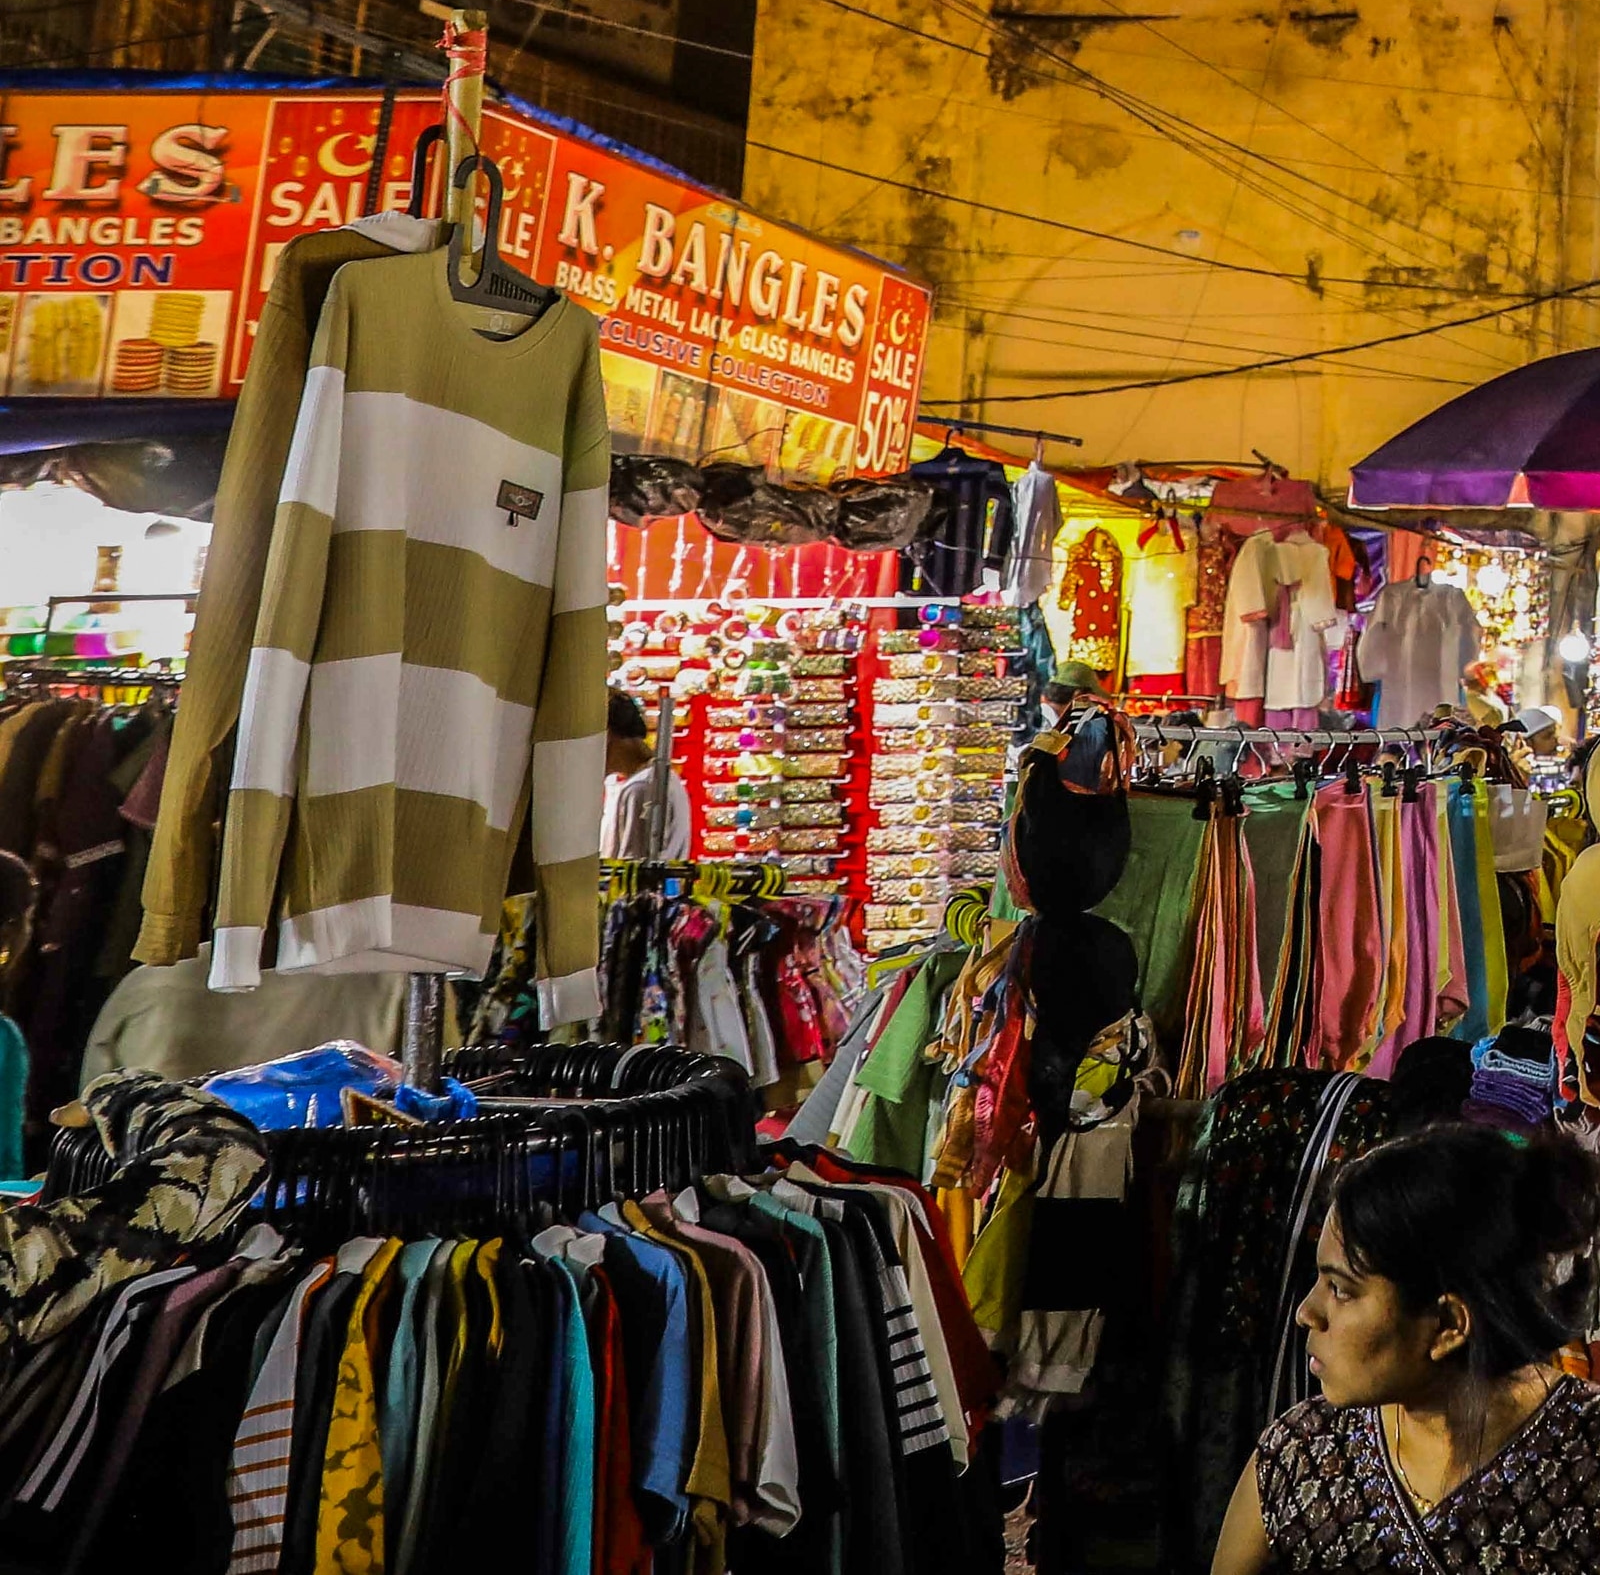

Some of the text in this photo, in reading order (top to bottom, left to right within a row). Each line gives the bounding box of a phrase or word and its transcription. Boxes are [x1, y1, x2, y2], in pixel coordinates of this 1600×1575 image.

[266, 181, 412, 226] SALE
[0, 216, 205, 246] BANGLES
[2, 252, 176, 287] TION
[637, 203, 870, 347] BANGLES
[555, 261, 620, 308] BRASS,
[625, 286, 686, 333] METAL,
[689, 307, 736, 347] LACK,
[739, 325, 788, 362] GLASS
[789, 342, 855, 383] BANGLES
[597, 314, 830, 408] XCLUSIVE COLLECTION
[870, 342, 917, 391] SALE
